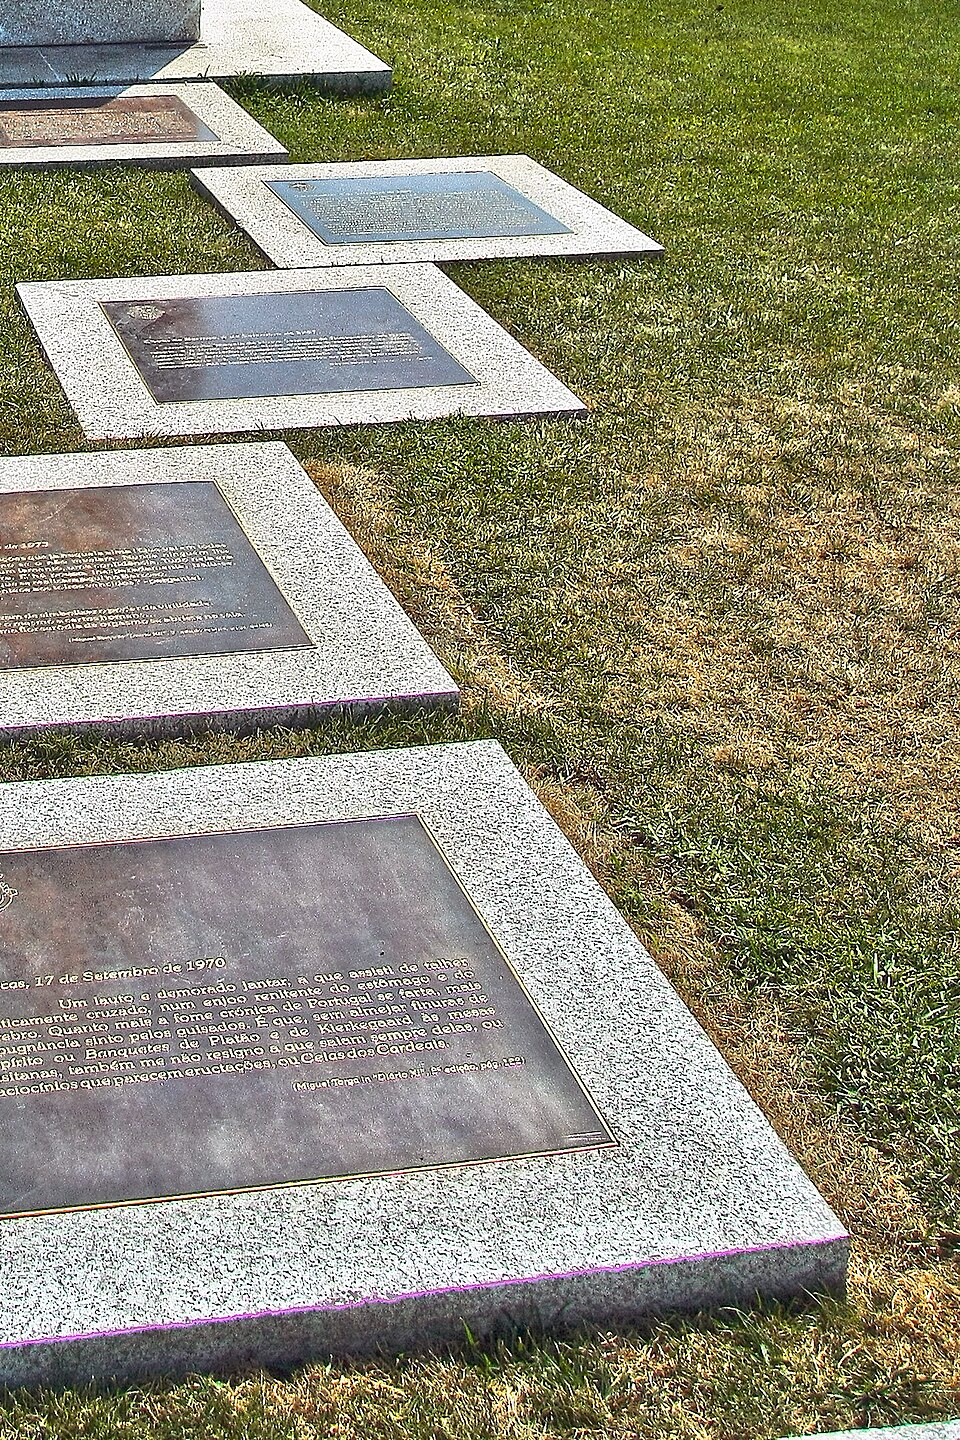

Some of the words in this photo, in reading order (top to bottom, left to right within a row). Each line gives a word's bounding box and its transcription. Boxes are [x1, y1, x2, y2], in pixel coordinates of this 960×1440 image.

[35, 975, 53, 986] 17
[59, 974, 77, 983] de
[83, 965, 157, 981] Setembro
[162, 961, 180, 972] de
[186, 958, 226, 970] 1970
[58, 999, 87, 1008] Um
[94, 995, 132, 1005] lauto
[157, 980, 235, 998] demorado
[297, 977, 308, 985] a
[314, 972, 342, 983] que
[349, 966, 393, 978] assisti
[400, 963, 417, 972] de
[424, 958, 467, 969] talher
[86, 1005, 150, 1018] cruzado,
[160, 1001, 195, 1011] num
[203, 996, 246, 1006] enjoo
[254, 988, 320, 1000] renitente
[330, 983, 348, 992] do
[358, 977, 429, 989] estômago
[433, 971, 446, 980] e
[454, 969, 473, 978] do
[48, 1023, 107, 1036] Quanto
[115, 1017, 151, 1028] mais
[174, 1012, 212, 1022] fome
[283, 1001, 302, 1011] de
[307, 993, 371, 1008] Portugal
[377, 992, 392, 1000] se
[446, 982, 480, 992] mais
[86, 1034, 122, 1045] sinto
[129, 1029, 170, 1043] pelos
[253, 1012, 267, 1026] É
[313, 1012, 344, 1020] sem
[350, 1004, 406, 1016] almejar
[411, 998, 463, 1010] finuras
[469, 994, 487, 1003] de
[54, 1054, 75, 1062] ou
[86, 1044, 168, 1058] Banquetes
[180, 1038, 198, 1048] de
[209, 1033, 259, 1045] Platão
[270, 1032, 278, 1041] e
[290, 1026, 308, 1036] de
[318, 1015, 412, 1033] Kierkegaard
[448, 1007, 494, 1020] mesas
[69, 1061, 134, 1074] também
[140, 1058, 163, 1066] me
[170, 1054, 200, 1063] não
[206, 1047, 263, 1060] resigno
[284, 1042, 313, 1052] que
[320, 1036, 365, 1048] saiam
[370, 1025, 426, 1044] sempre
[432, 1023, 476, 1034] delas,
[482, 1020, 502, 1029] ou
[80, 1078, 109, 1089] que
[113, 1070, 182, 1086] parecem
[278, 1056, 299, 1068] ou
[347, 1048, 374, 1058] dos
[293, 1079, 330, 1091] (Miguel
